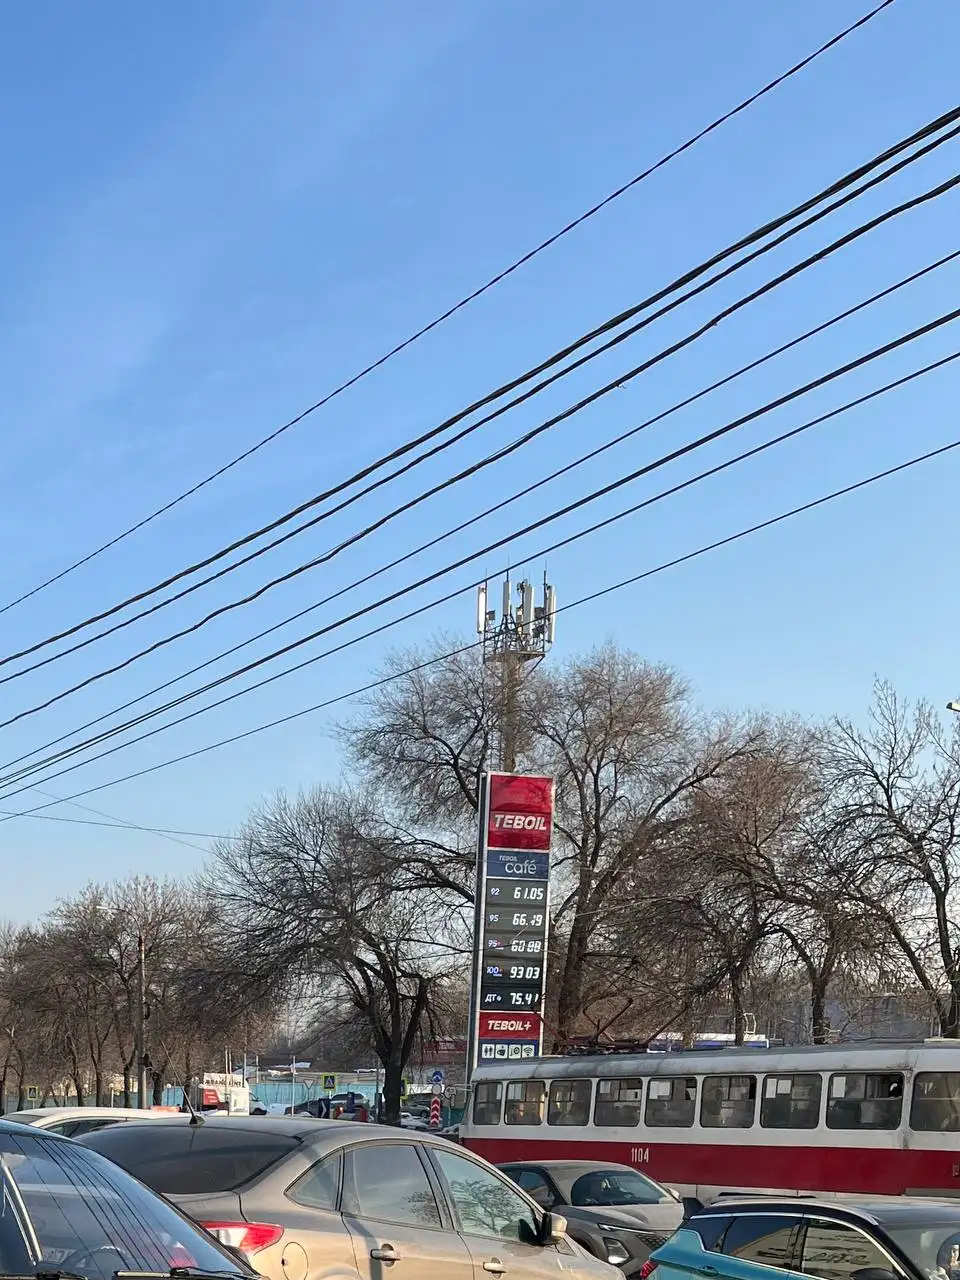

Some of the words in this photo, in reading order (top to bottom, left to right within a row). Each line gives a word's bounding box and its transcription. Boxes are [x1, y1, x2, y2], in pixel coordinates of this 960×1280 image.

[495, 814, 548, 831] TEBOIL
[505, 859, 537, 875] café
[490, 887, 500, 896] 92
[513, 886, 544, 900] 61.05
[489, 914, 499, 922] 95
[488, 1020, 532, 1031] TEBOIL+
[631, 1147, 649, 1163] 1104
